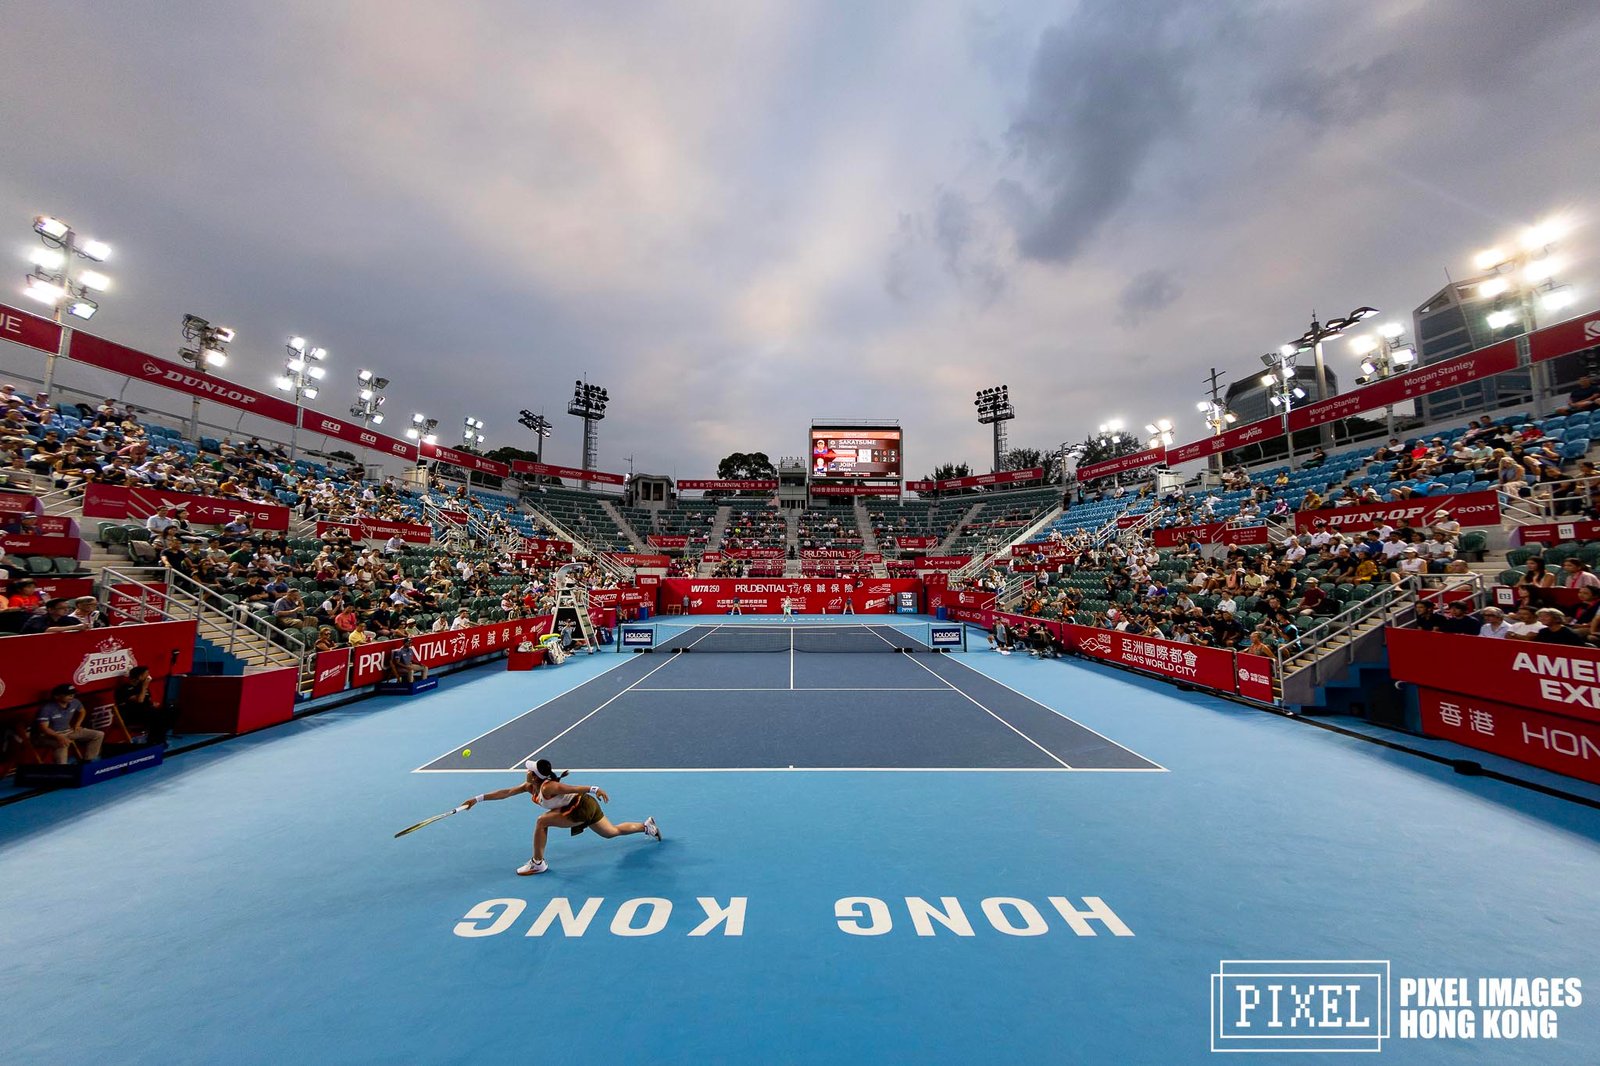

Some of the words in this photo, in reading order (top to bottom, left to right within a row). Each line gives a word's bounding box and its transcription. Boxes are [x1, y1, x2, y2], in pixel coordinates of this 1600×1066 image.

[1405, 371, 1438, 387] Morgan
[1438, 360, 1475, 376] Stanley
[163, 369, 256, 404] DUNLOP
[1309, 404, 1333, 416] Morgan
[1333, 396, 1360, 408] Stanley
[321, 420, 341, 431] ECO
[360, 432, 377, 443] ECO
[393, 443, 407, 453] ECO
[1328, 507, 1425, 526] DUNLOP
[1457, 504, 1496, 514] SONY
[803, 550, 847, 558] PRUDENTIAL
[691, 584, 709, 593] WTA
[709, 584, 720, 593] 250
[735, 584, 787, 593] PRUDENTIAL
[89, 655, 126, 667] STELLA
[359, 640, 449, 676] PRUNTIAL
[1121, 638, 1198, 667] 亞洲國際都會
[88, 662, 126, 675] ARTOIS
[1121, 653, 1145, 665] ASIA'S
[1145, 657, 1175, 672] WORLD
[1175, 665, 1197, 677] CITY
[1512, 652, 1600, 683] AME
[1439, 701, 1496, 737] 香港
[453, 896, 748, 938] KONG
[834, 896, 1136, 937] HONG
